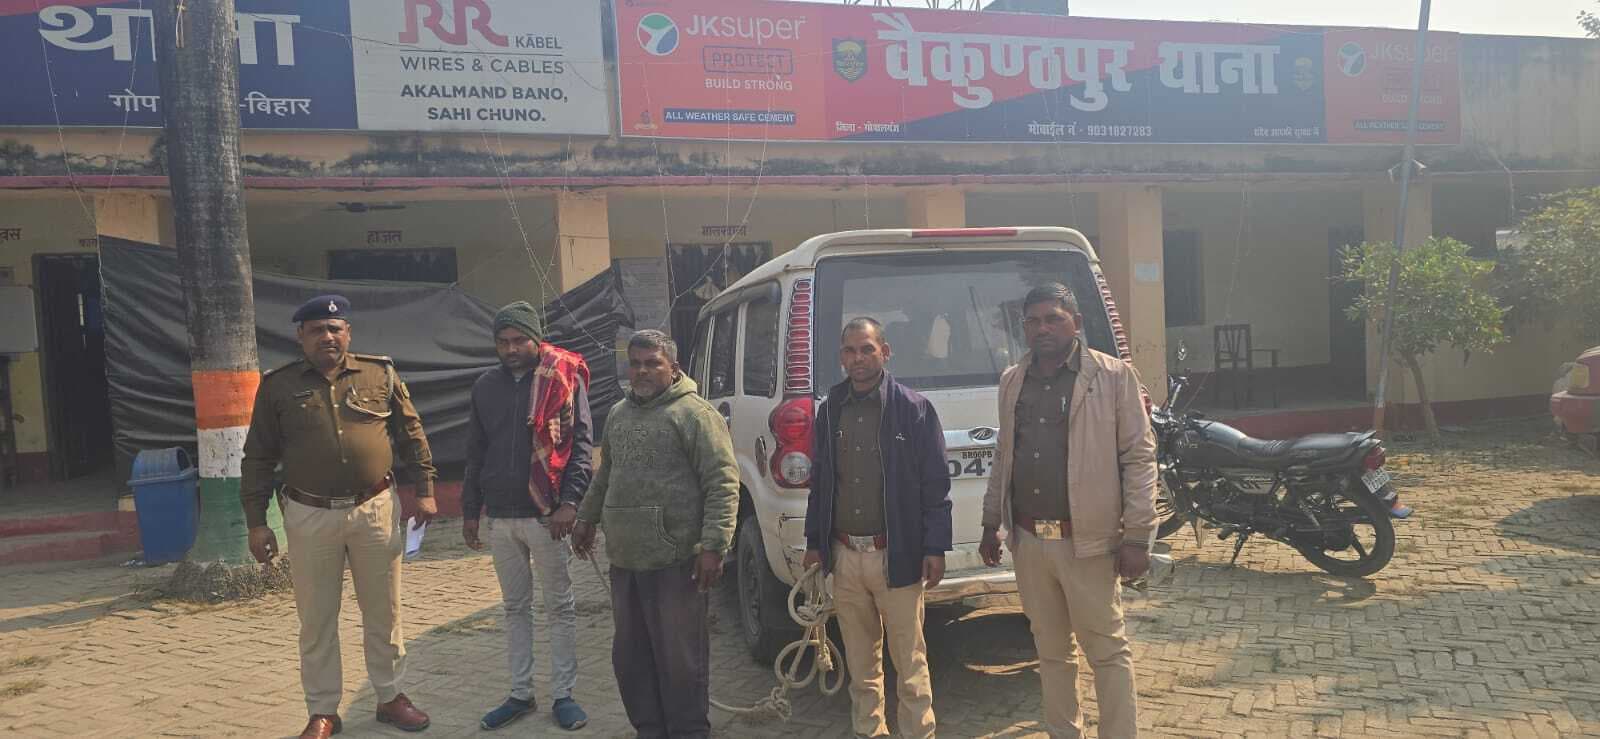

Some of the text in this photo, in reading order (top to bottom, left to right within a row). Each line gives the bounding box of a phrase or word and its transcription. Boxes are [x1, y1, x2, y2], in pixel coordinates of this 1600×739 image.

[401, 56, 565, 74] WIRES & CABLES
[712, 52, 785, 68] PROTECT
[872, 12, 1281, 112] वैकुण्ठपुर थाना
[401, 84, 568, 102] AKALMAND BANO,
[705, 78, 793, 91] BUILD STRONG
[427, 107, 546, 121] SAHI CHUNO.
[665, 111, 795, 123] ALL WEATHER SAFE CEMENT
[945, 459, 993, 478] 04
